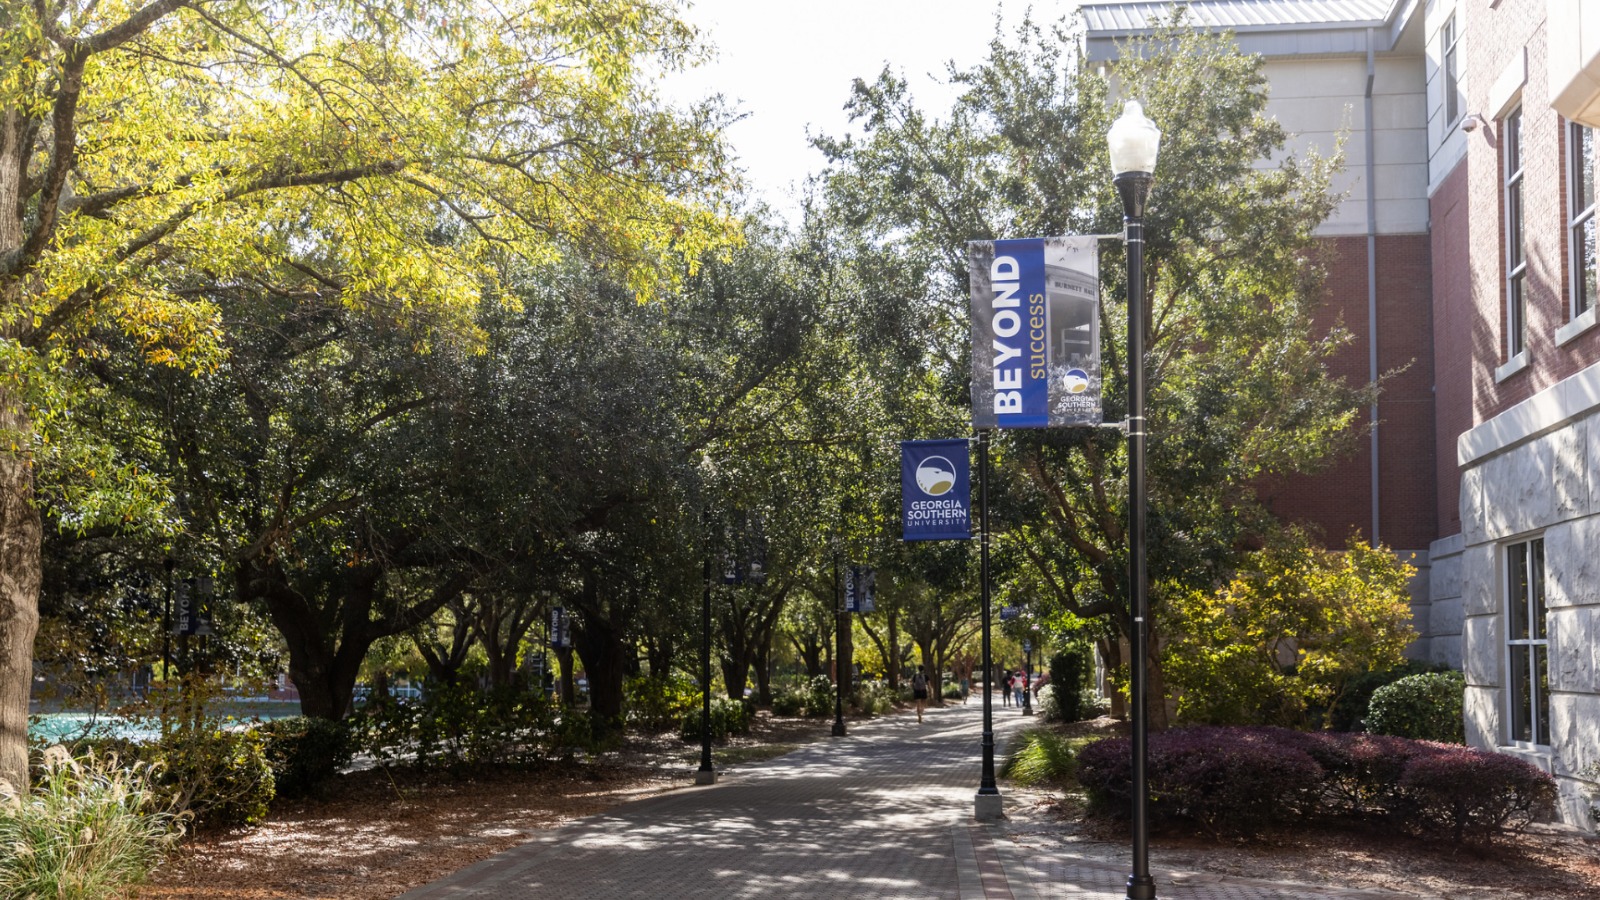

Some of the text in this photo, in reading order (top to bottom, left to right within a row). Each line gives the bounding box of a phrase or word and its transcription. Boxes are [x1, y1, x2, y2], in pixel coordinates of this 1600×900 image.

[990, 255, 1022, 415] BEYOND
[1030, 293, 1045, 380] success
[907, 509, 966, 520] SOUTHERN
[911, 500, 962, 510] GEORGIA
[551, 610, 559, 642] BEYOND
